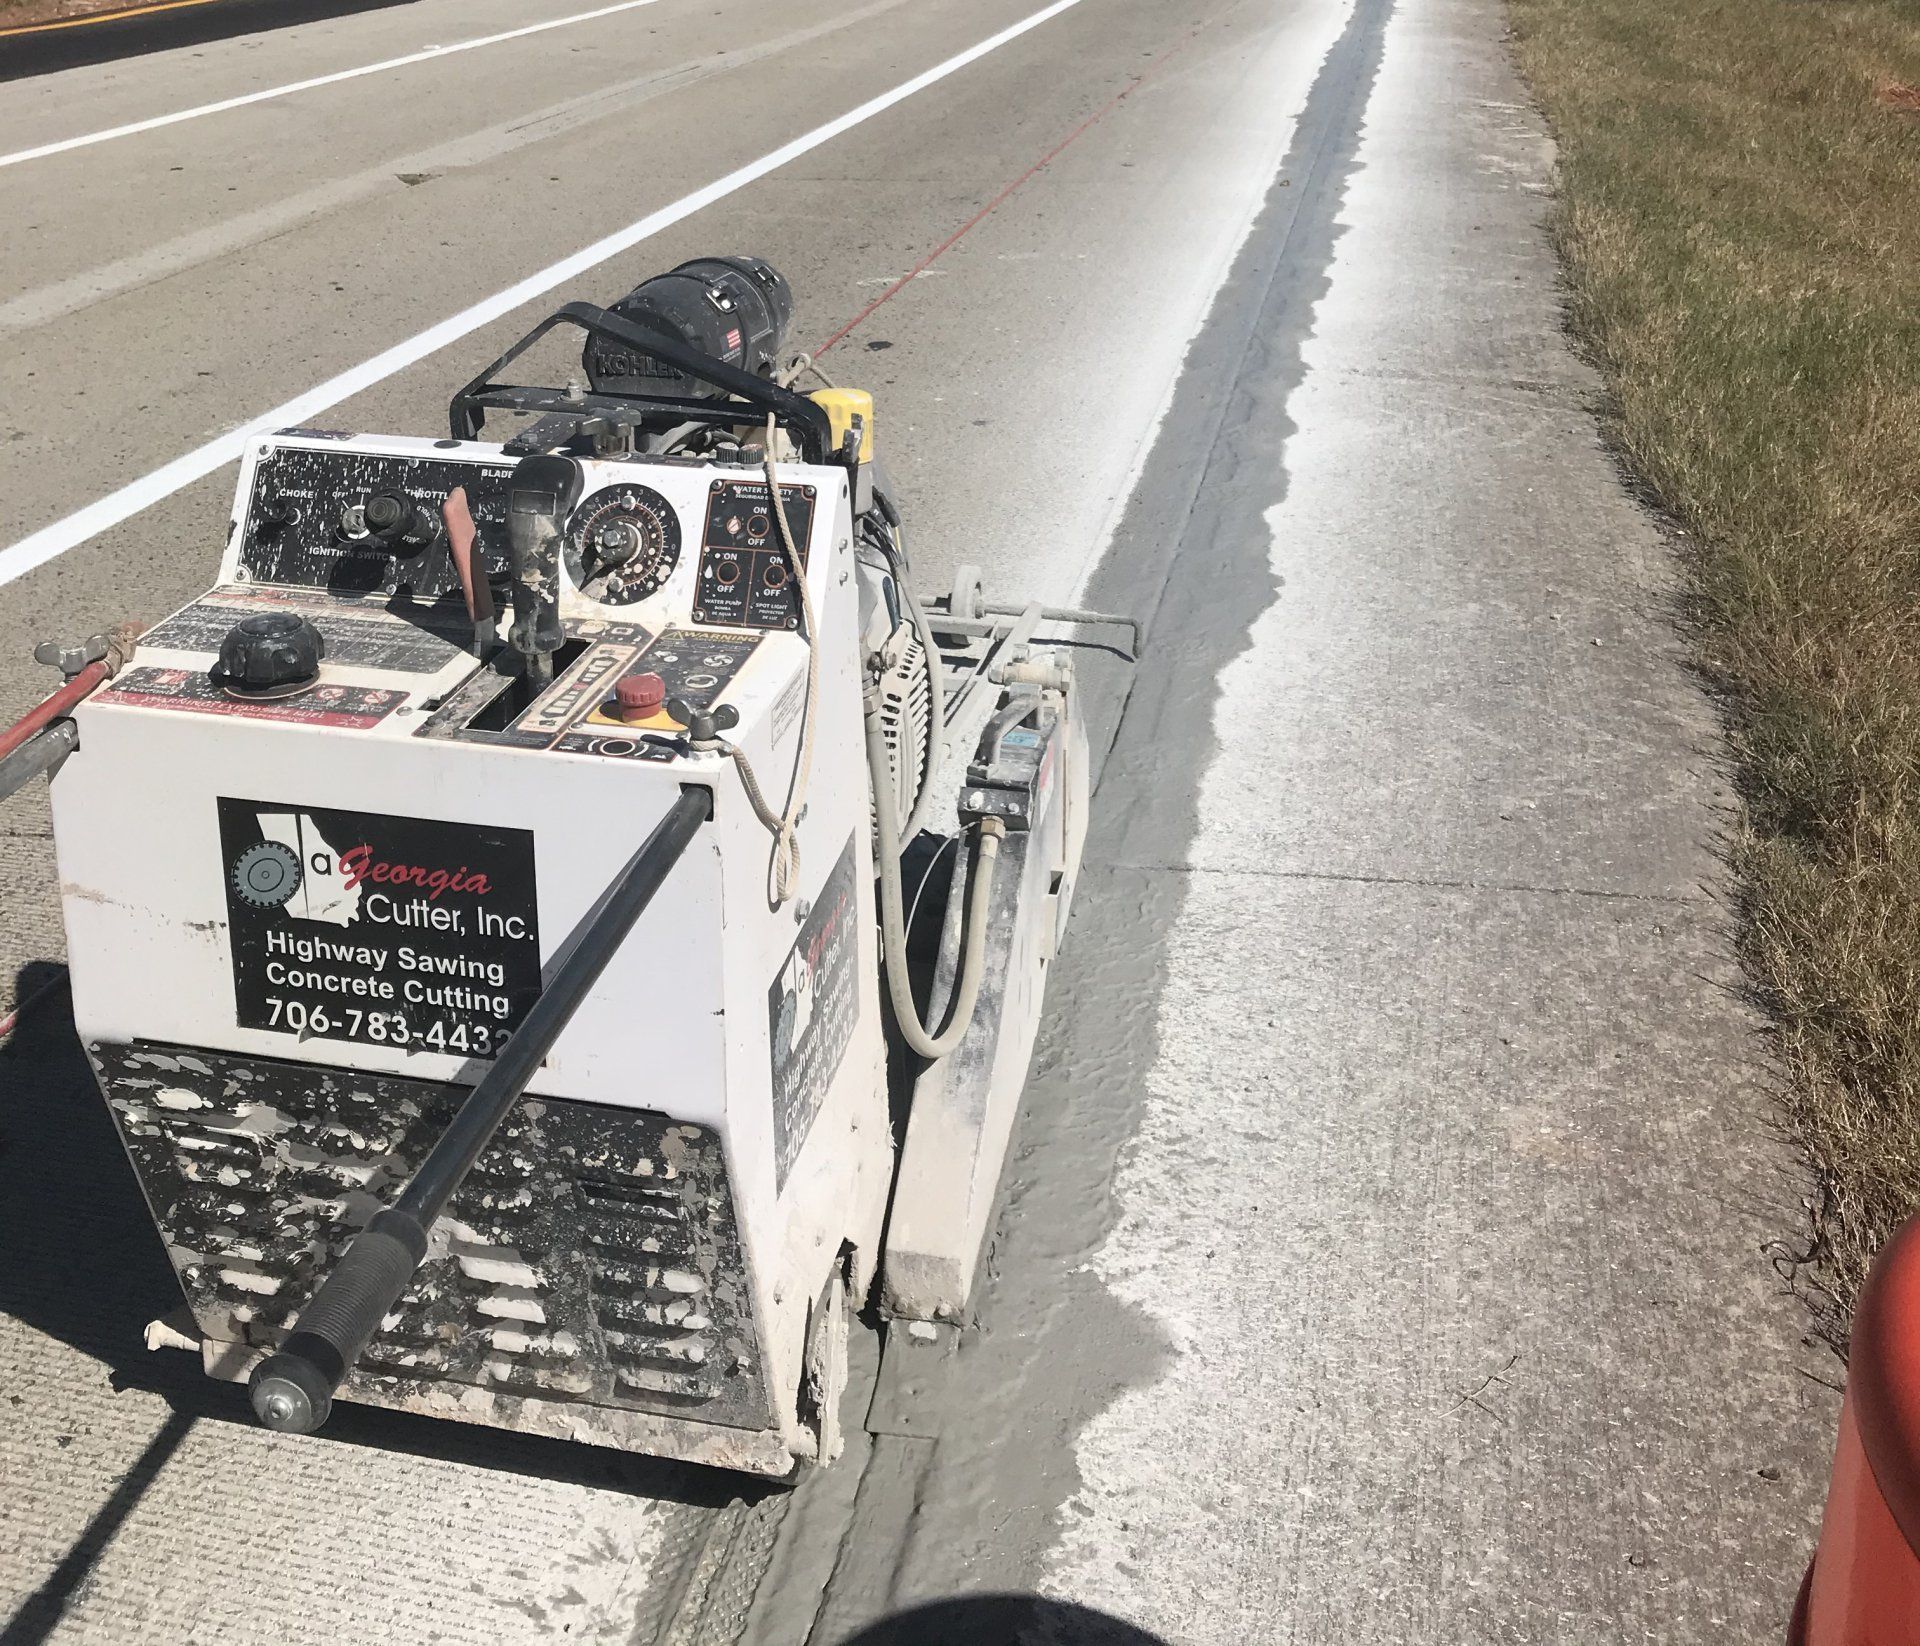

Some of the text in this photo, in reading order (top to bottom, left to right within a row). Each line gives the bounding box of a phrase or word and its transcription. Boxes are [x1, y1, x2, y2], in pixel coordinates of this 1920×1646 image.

[481, 468, 514, 479] BLADE
[279, 488, 315, 499] CHOKE
[356, 486, 372, 494] RUN
[404, 488, 449, 500] THROTTL
[735, 486, 793, 496] WATER SETY
[753, 506, 768, 515] ON
[747, 538, 766, 546] OFF
[356, 550, 394, 562] SWITC
[723, 552, 738, 561] ON
[769, 556, 784, 565] ON
[717, 585, 735, 593] OFF
[763, 588, 781, 597] OFF
[684, 631, 760, 643] WARNING
[338, 845, 494, 901] Georgia
[366, 893, 535, 941] Cutter, Inc.
[266, 930, 505, 987] Highway Sawing
[266, 961, 510, 1018] Concrete Cutting
[265, 998, 514, 1056] 706-783-4432
